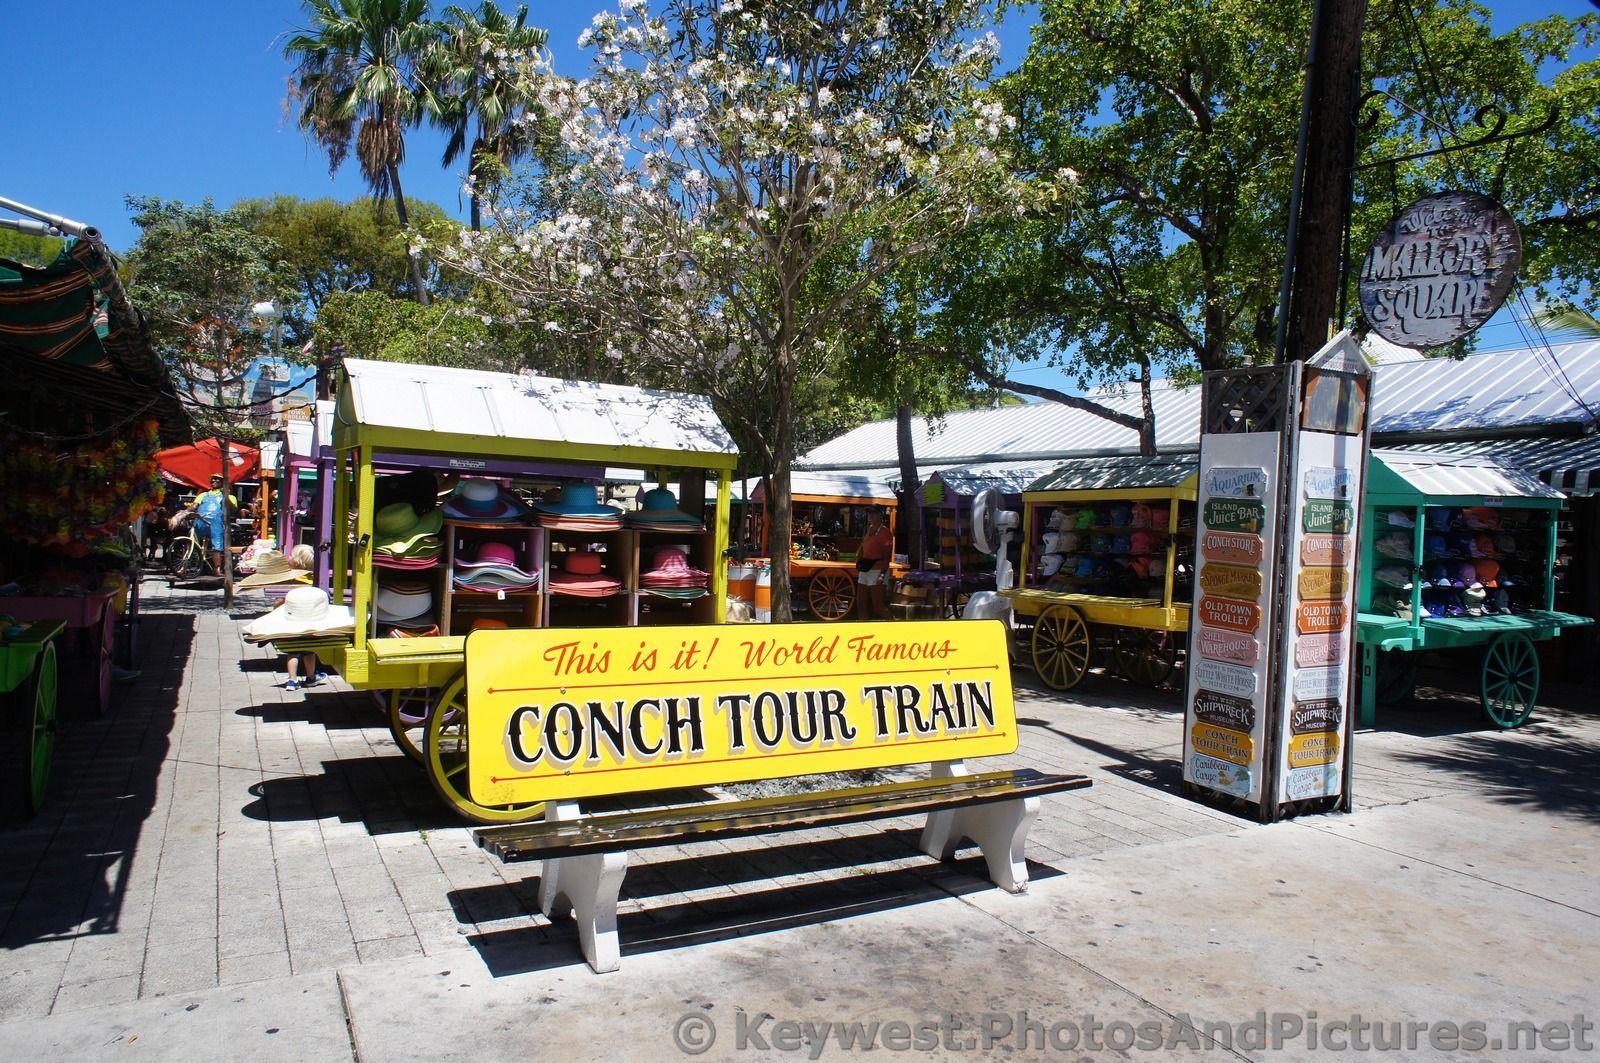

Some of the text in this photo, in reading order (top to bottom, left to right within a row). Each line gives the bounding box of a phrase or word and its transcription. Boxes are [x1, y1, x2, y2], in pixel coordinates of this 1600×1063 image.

[1209, 472, 1261, 493] AQUARIUM
[1310, 473, 1351, 494] AQUARIUM
[1212, 503, 1238, 511] ISLAND
[1237, 507, 1260, 519] BAR
[1311, 504, 1333, 512] ISLAND
[1333, 508, 1352, 520] BAR
[1207, 535, 1256, 556] CONCH STORE
[1306, 539, 1347, 555] CONCH STORE
[1204, 570, 1256, 587] SPONGE MARKET
[1303, 572, 1346, 593] SPONGE MARKET
[1205, 601, 1252, 616] OLD TOWN
[1303, 606, 1343, 616] OLD TOWN
[1209, 611, 1250, 626] TROLLEY
[1307, 616, 1340, 627] TROLLEY
[1203, 631, 1225, 643] SHELL
[1303, 639, 1320, 648] SHELL
[543, 634, 958, 676] This is it! World Famous
[1201, 640, 1251, 656] WAREHOUSE
[1300, 640, 1341, 662] WAREHOUSE
[1203, 663, 1220, 671] HARRY
[1227, 667, 1248, 676] TRUMAN
[1197, 668, 1253, 689] LITTLE WHITE HOUSE
[1208, 680, 1239, 692] MUSEUM
[1297, 679, 1312, 690] LITTLE
[1312, 679, 1327, 688] WHITE
[1195, 698, 1250, 726] SHIPWRECK
[1209, 714, 1235, 725] MUSEUM
[1294, 707, 1340, 727] SHIPWRECK
[506, 680, 996, 766] CONCH TOUR TRAIN
[1305, 721, 1327, 730] MUSEUM
[1205, 728, 1239, 745] CONCH
[1302, 736, 1330, 749] CONCH
[1194, 736, 1248, 759] TOUR TRAIN
[1293, 747, 1337, 761] TOUR TRAIN
[1195, 758, 1231, 772] Caribbean
[1195, 768, 1217, 785] Cargo
[1292, 769, 1323, 784] Caribbean
[1292, 782, 1312, 795] Cargo
